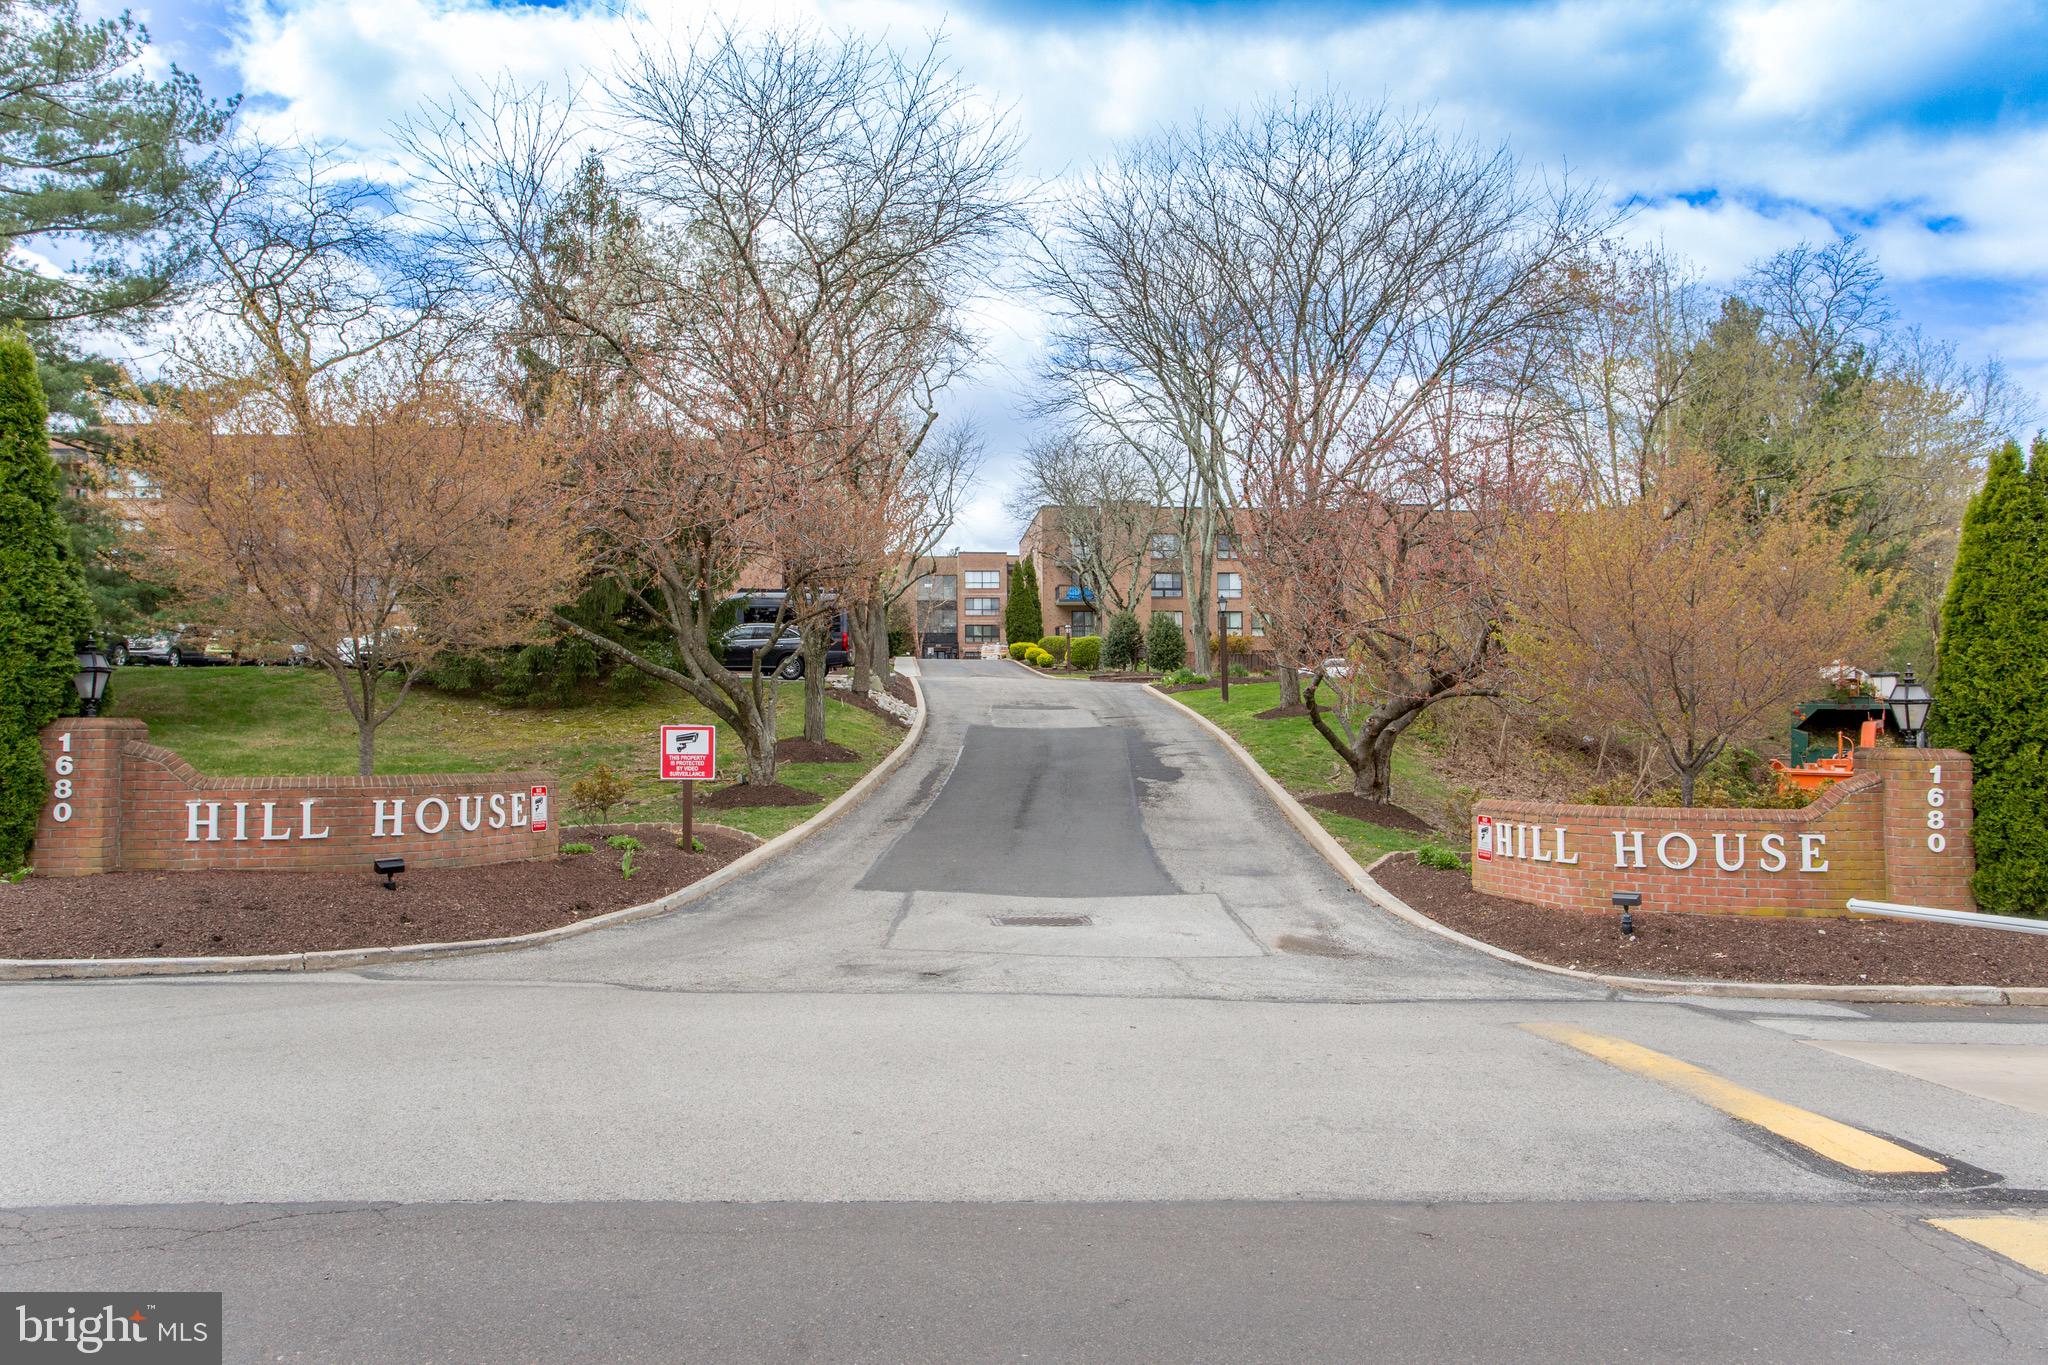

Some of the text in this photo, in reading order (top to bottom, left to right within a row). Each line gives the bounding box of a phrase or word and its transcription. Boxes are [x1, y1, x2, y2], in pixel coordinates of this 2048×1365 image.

[54, 733, 74, 823] 1680
[1926, 764, 1946, 853] 1680
[185, 792, 528, 842] HILL HOUSE
[1495, 823, 1829, 873] HILL HOUSE
